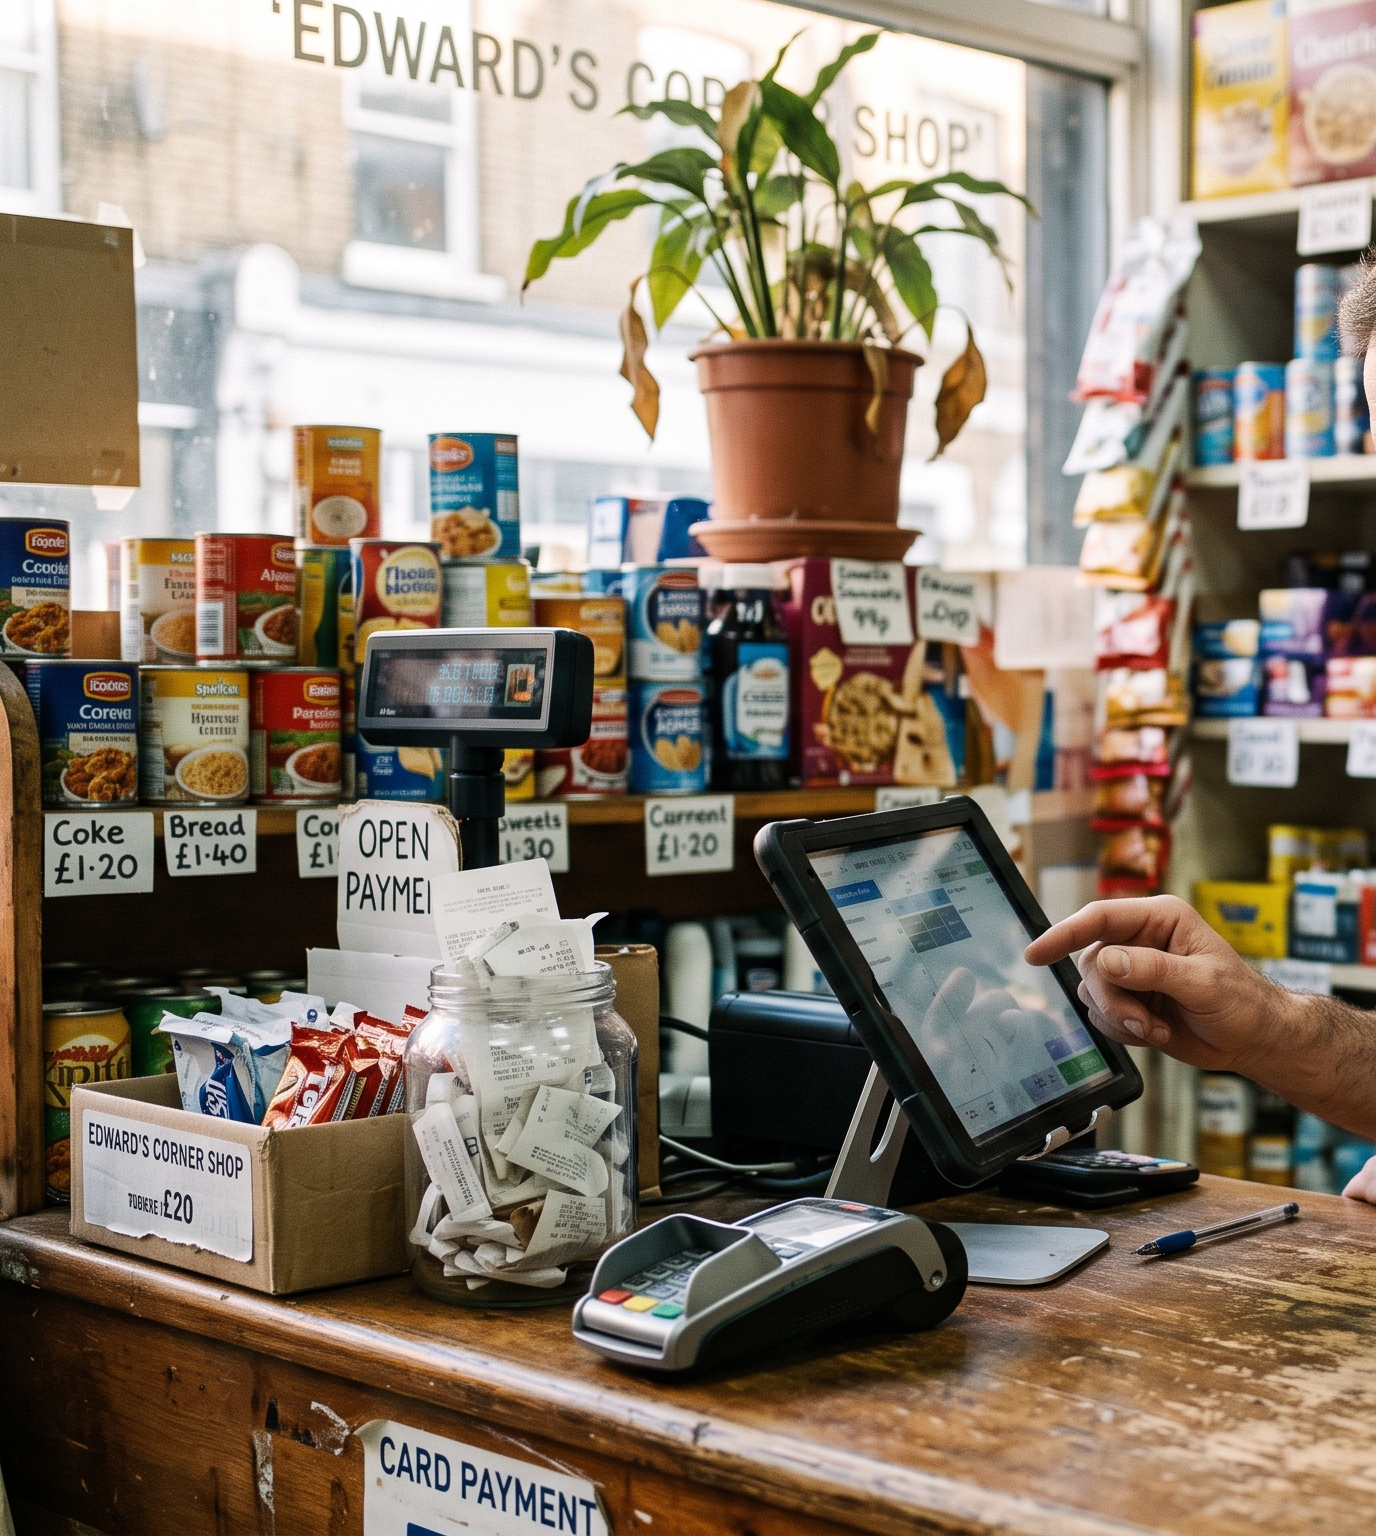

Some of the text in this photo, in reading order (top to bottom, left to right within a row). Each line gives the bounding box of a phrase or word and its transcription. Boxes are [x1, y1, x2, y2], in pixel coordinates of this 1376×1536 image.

[53, 820, 126, 846] Coke
[170, 815, 247, 838] Bread
[650, 804, 727, 827] Current
[358, 818, 430, 862] OPEN
[88, 1121, 244, 1180] EDWARD'S CORNER SHOP
[379, 1436, 597, 1536] CARD PAYMENT
